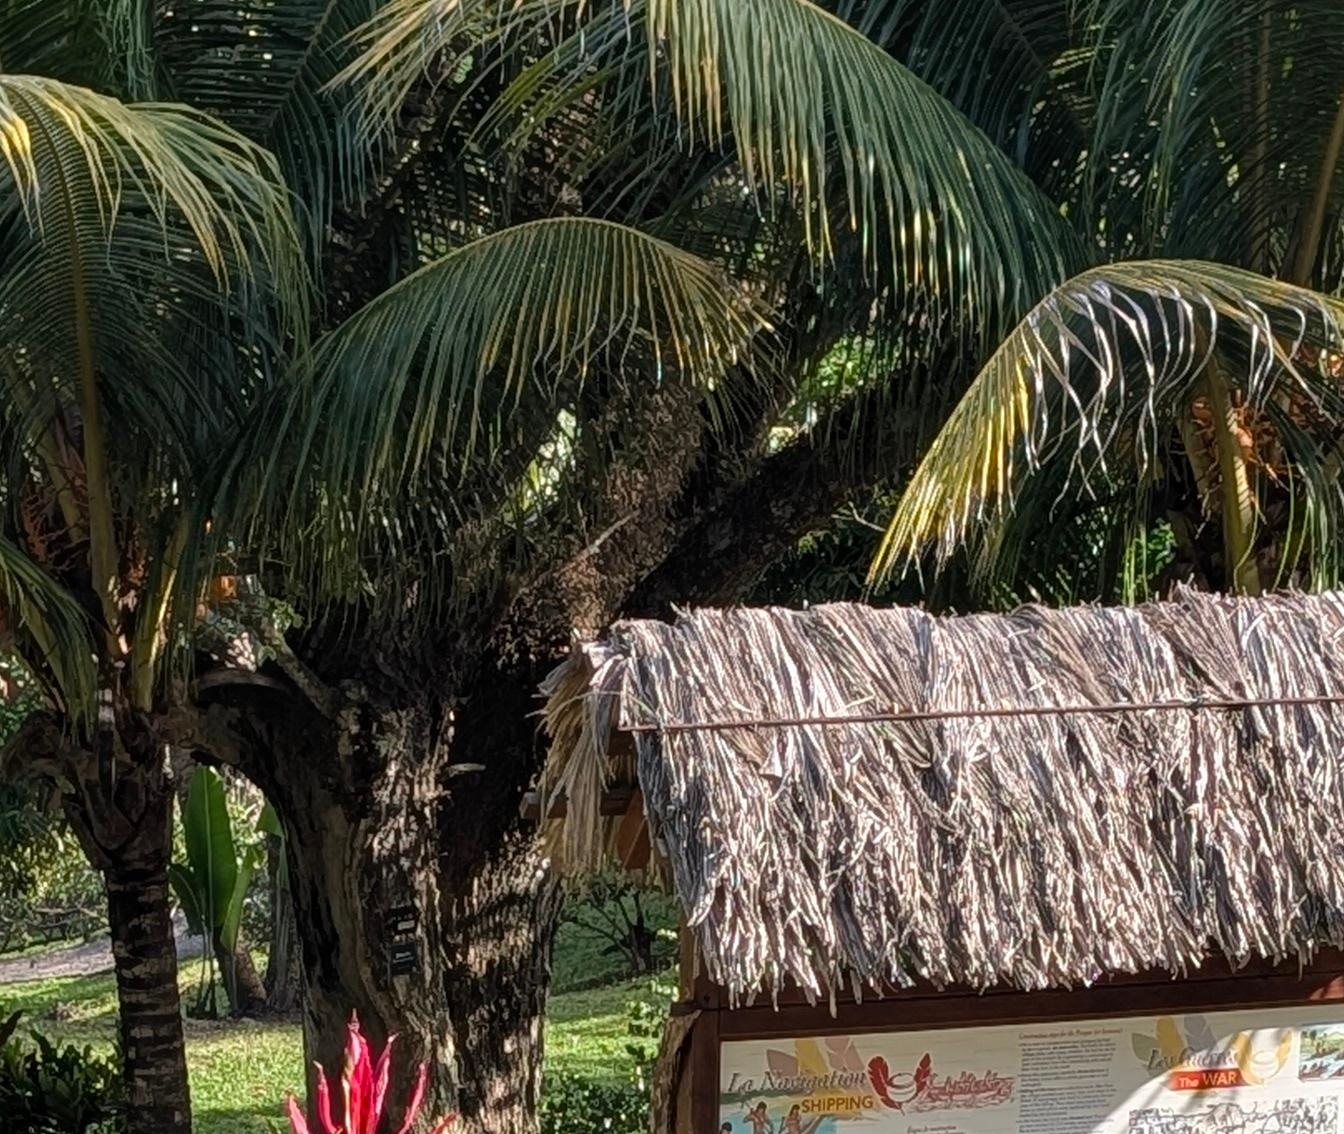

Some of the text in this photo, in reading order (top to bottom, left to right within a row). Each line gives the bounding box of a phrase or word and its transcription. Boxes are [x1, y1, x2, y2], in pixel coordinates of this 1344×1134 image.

[728, 1067, 866, 1096] La Navigation
[1179, 1071, 1237, 1088] The WAR
[801, 1095, 873, 1113] SHIPPING
